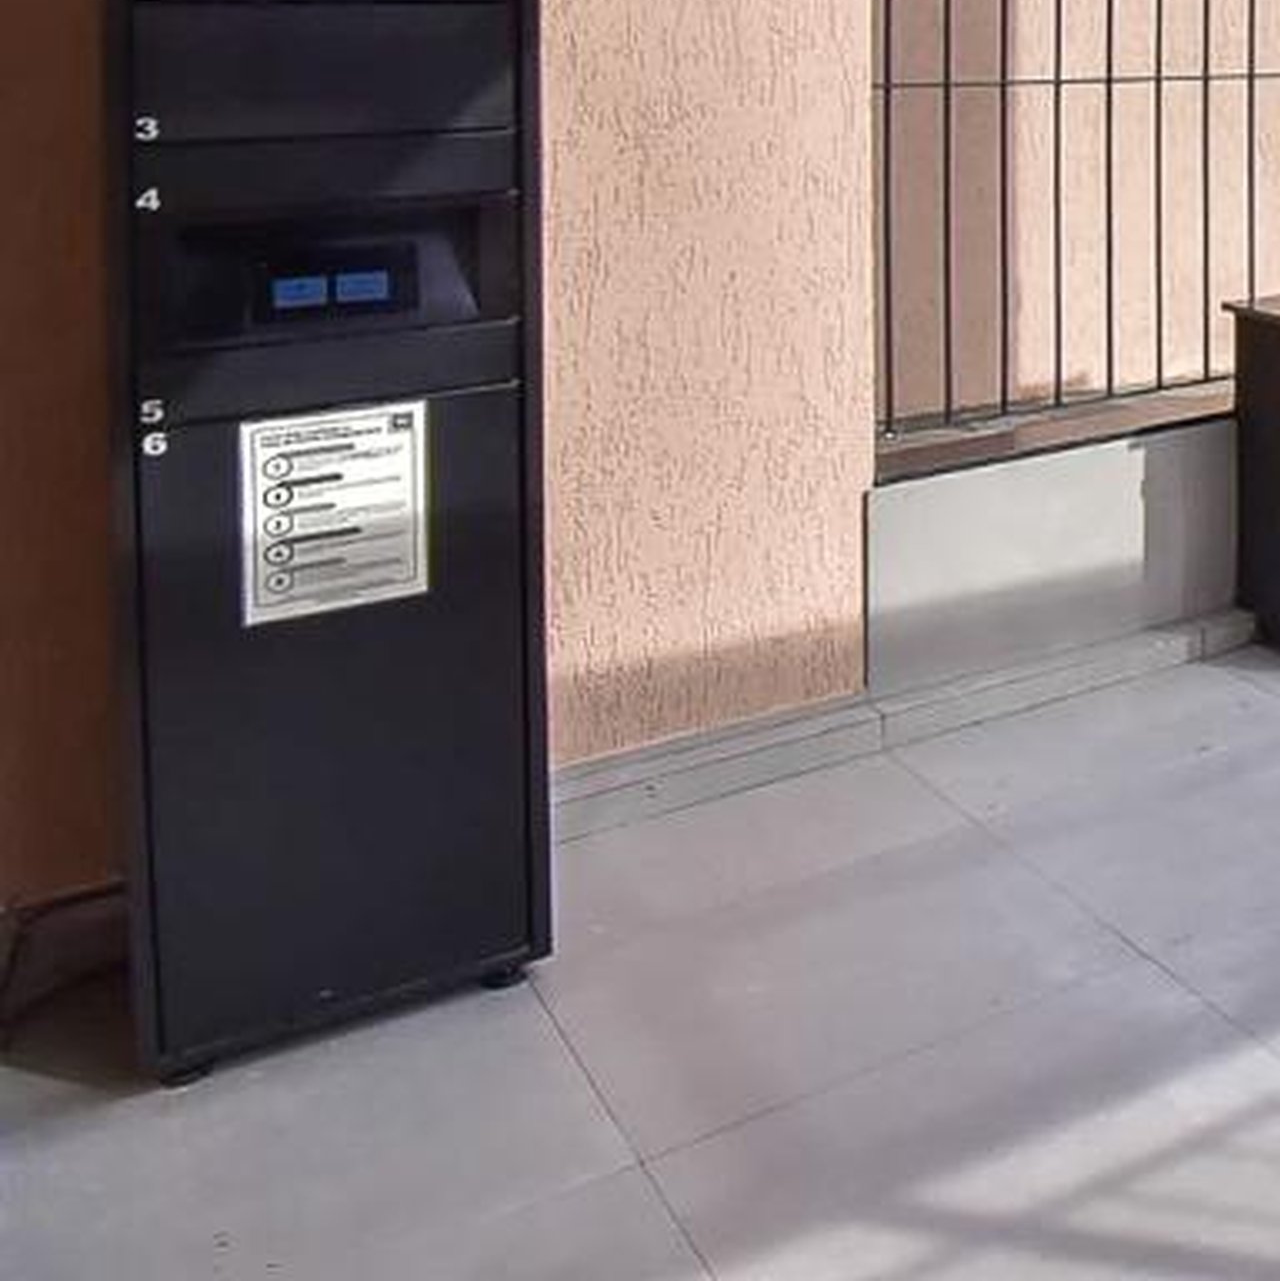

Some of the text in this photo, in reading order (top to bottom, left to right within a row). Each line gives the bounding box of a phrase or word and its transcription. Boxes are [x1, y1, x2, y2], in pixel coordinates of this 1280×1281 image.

[135, 116, 160, 140] 3
[135, 187, 161, 211] 4
[140, 399, 164, 423] 5
[143, 431, 168, 456] 6
